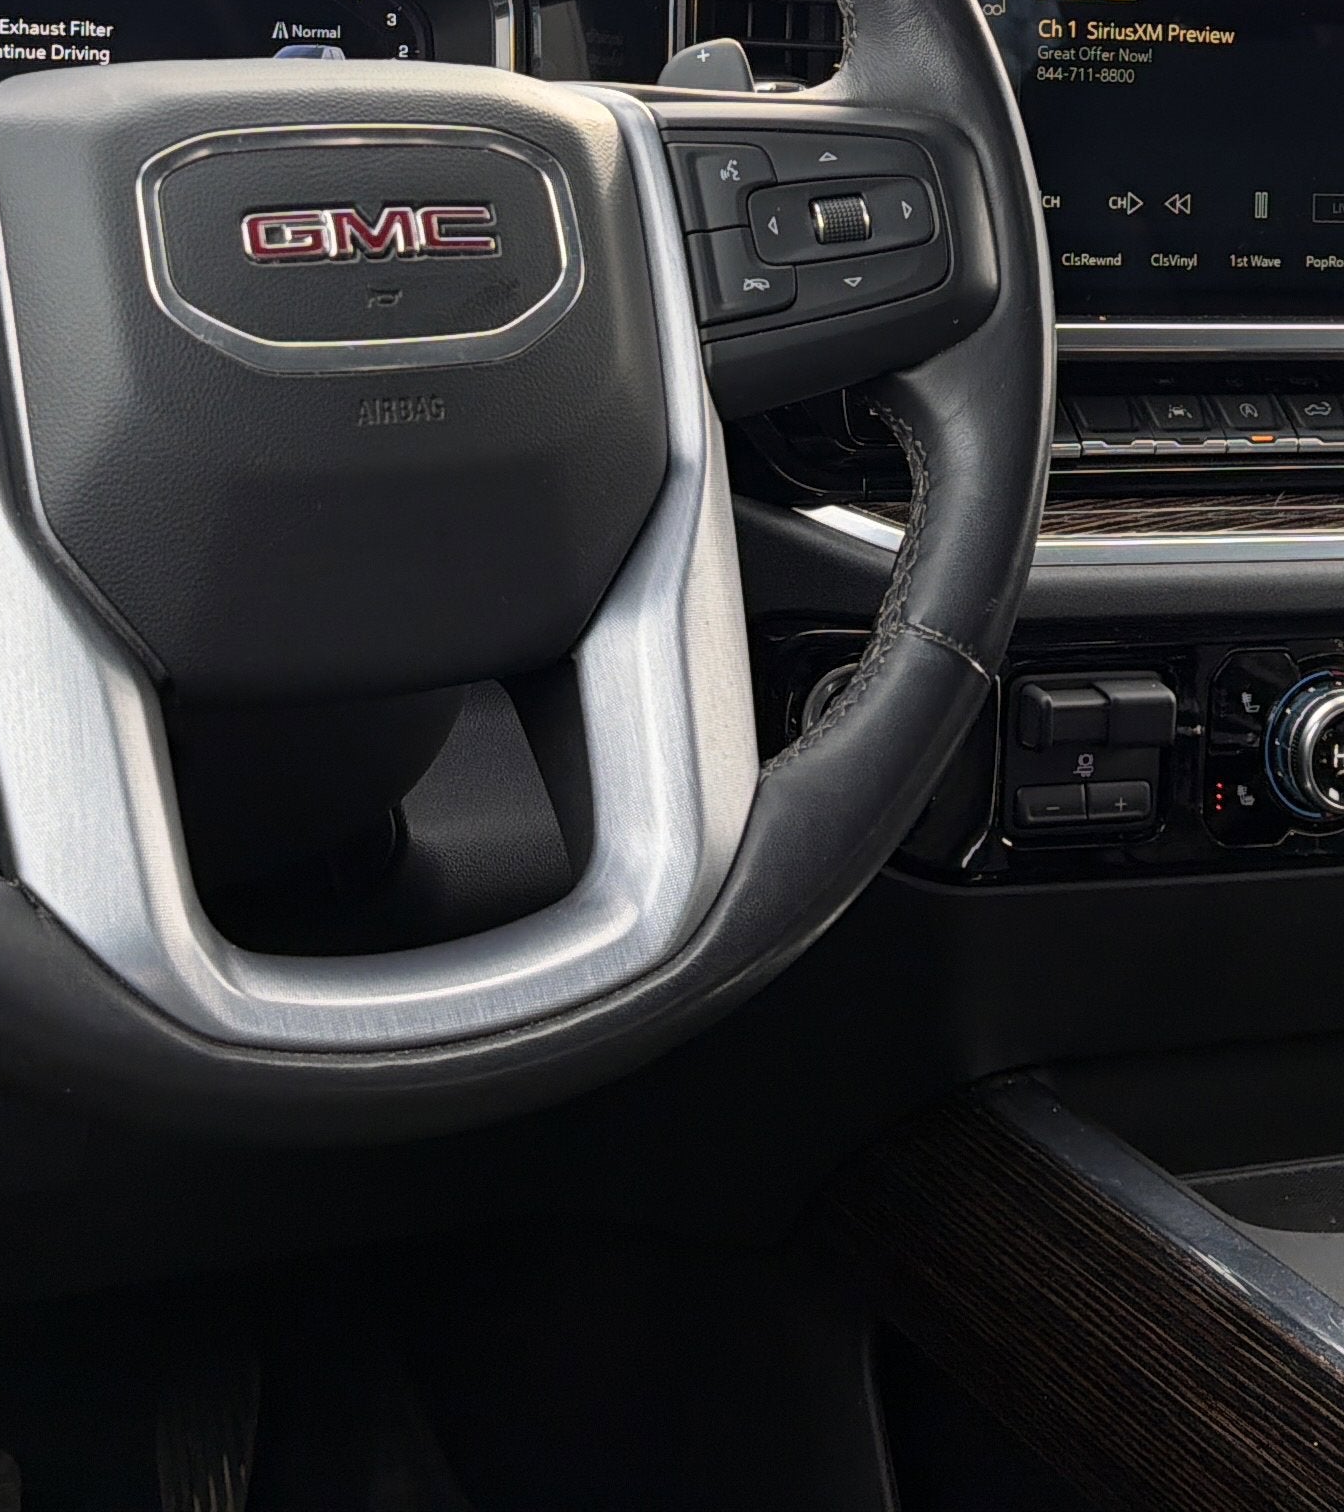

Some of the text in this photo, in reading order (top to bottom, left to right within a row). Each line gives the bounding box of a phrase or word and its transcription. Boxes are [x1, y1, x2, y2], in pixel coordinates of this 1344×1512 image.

[0, 18, 66, 37] Exhaust
[70, 20, 114, 38] Filter
[386, 13, 397, 27] 3
[292, 24, 342, 39] Normal
[1038, 19, 1235, 44] Ch 1 SiriusXM Preview
[51, 44, 111, 66] Driving
[398, 45, 409, 58] 2
[1037, 45, 1153, 64] Great Offer Now!
[1036, 66, 1135, 84] 844-711-8800
[1042, 195, 1061, 208] CH
[1108, 196, 1127, 209] CH
[242, 202, 501, 265] GMC
[1061, 252, 1122, 267] ClsRewnd
[1151, 253, 1198, 270] ClsVinyl
[1230, 254, 1281, 268] 1st Wave
[358, 397, 445, 426] AIRBAG
